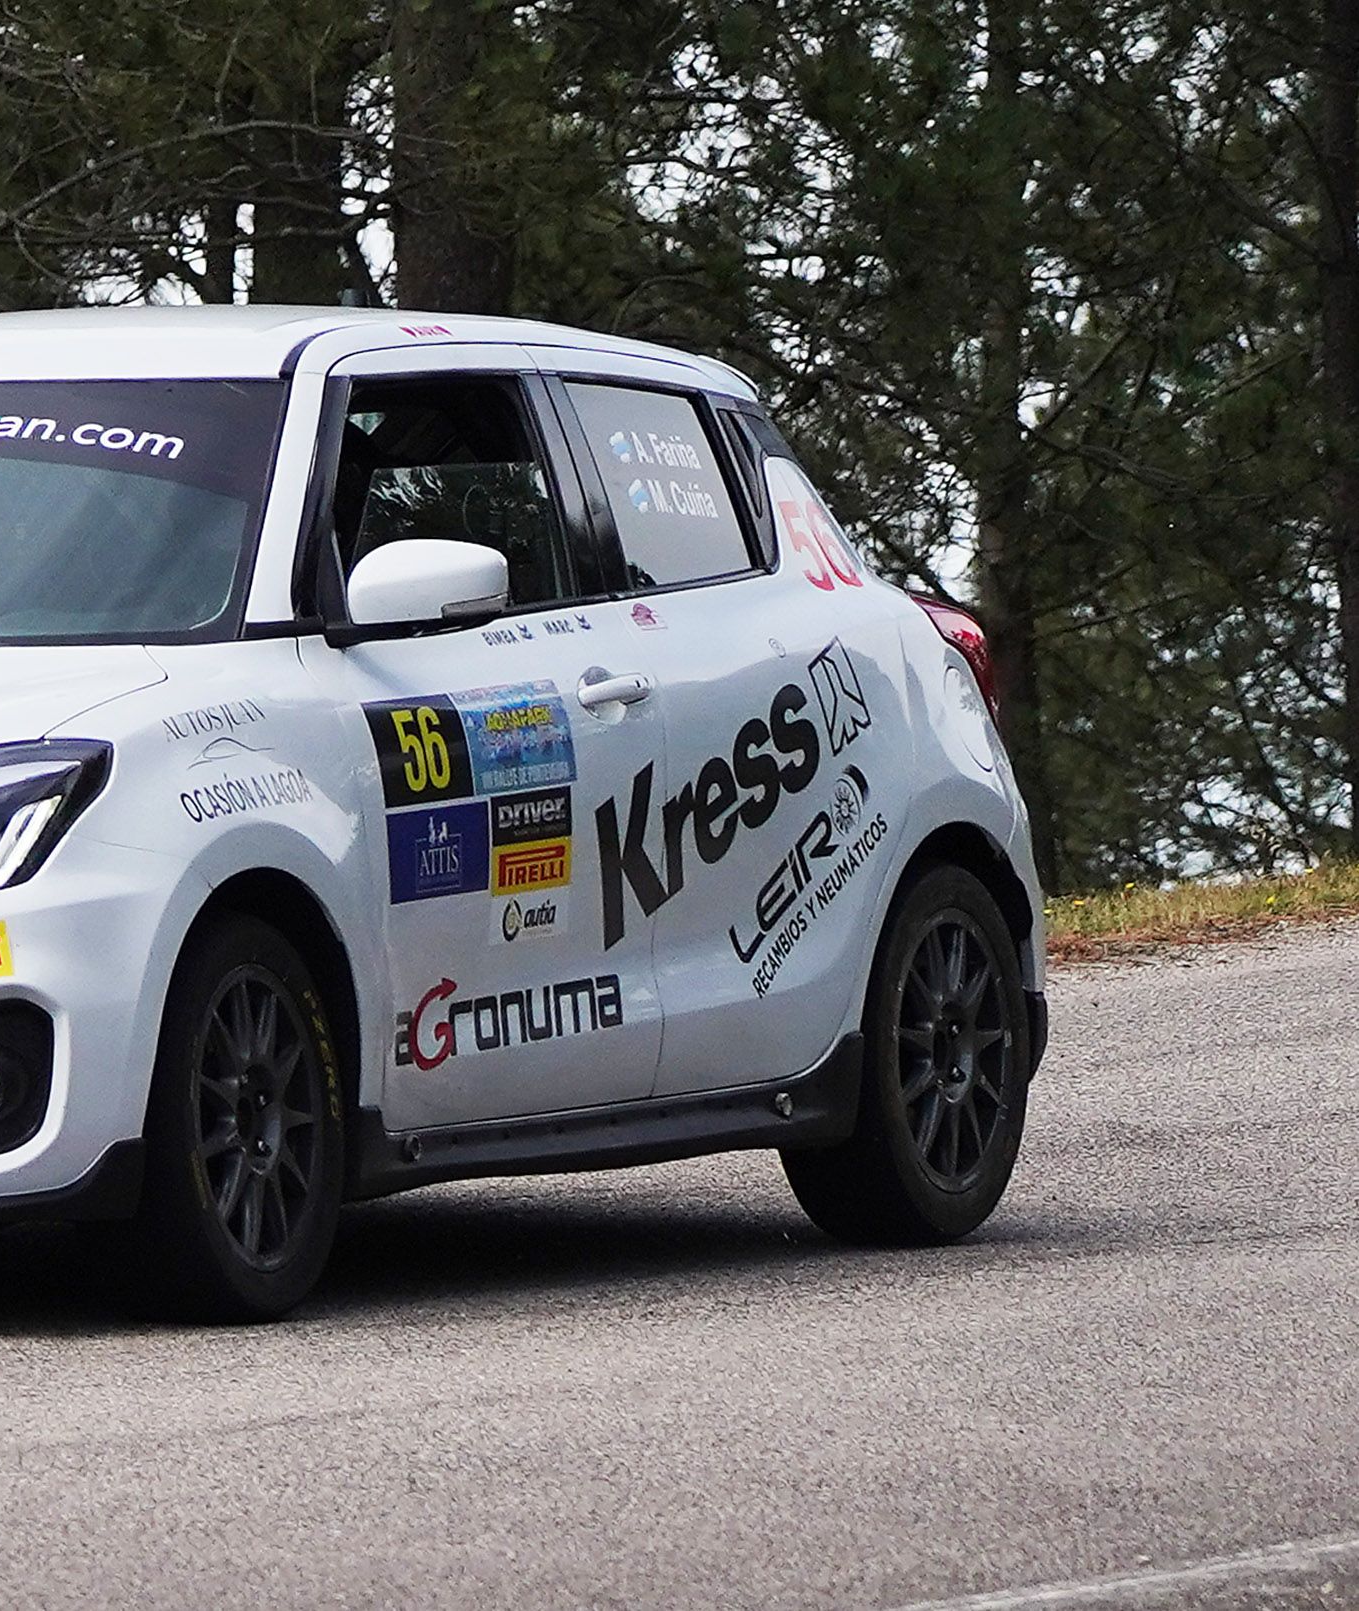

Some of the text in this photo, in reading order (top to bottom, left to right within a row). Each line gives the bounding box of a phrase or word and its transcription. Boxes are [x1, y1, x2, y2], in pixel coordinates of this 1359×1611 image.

[631, 431, 654, 464] A.
[646, 479, 674, 513] M.
[391, 706, 451, 793] 56
[180, 769, 314, 823] OCASIÓN A LAGOA
[595, 683, 820, 952] Kress
[419, 844, 460, 877] ATTIS
[498, 845, 566, 888] PIRELLI
[752, 812, 888, 1000] RECAMBIOS Y NEUMÁTICOS
